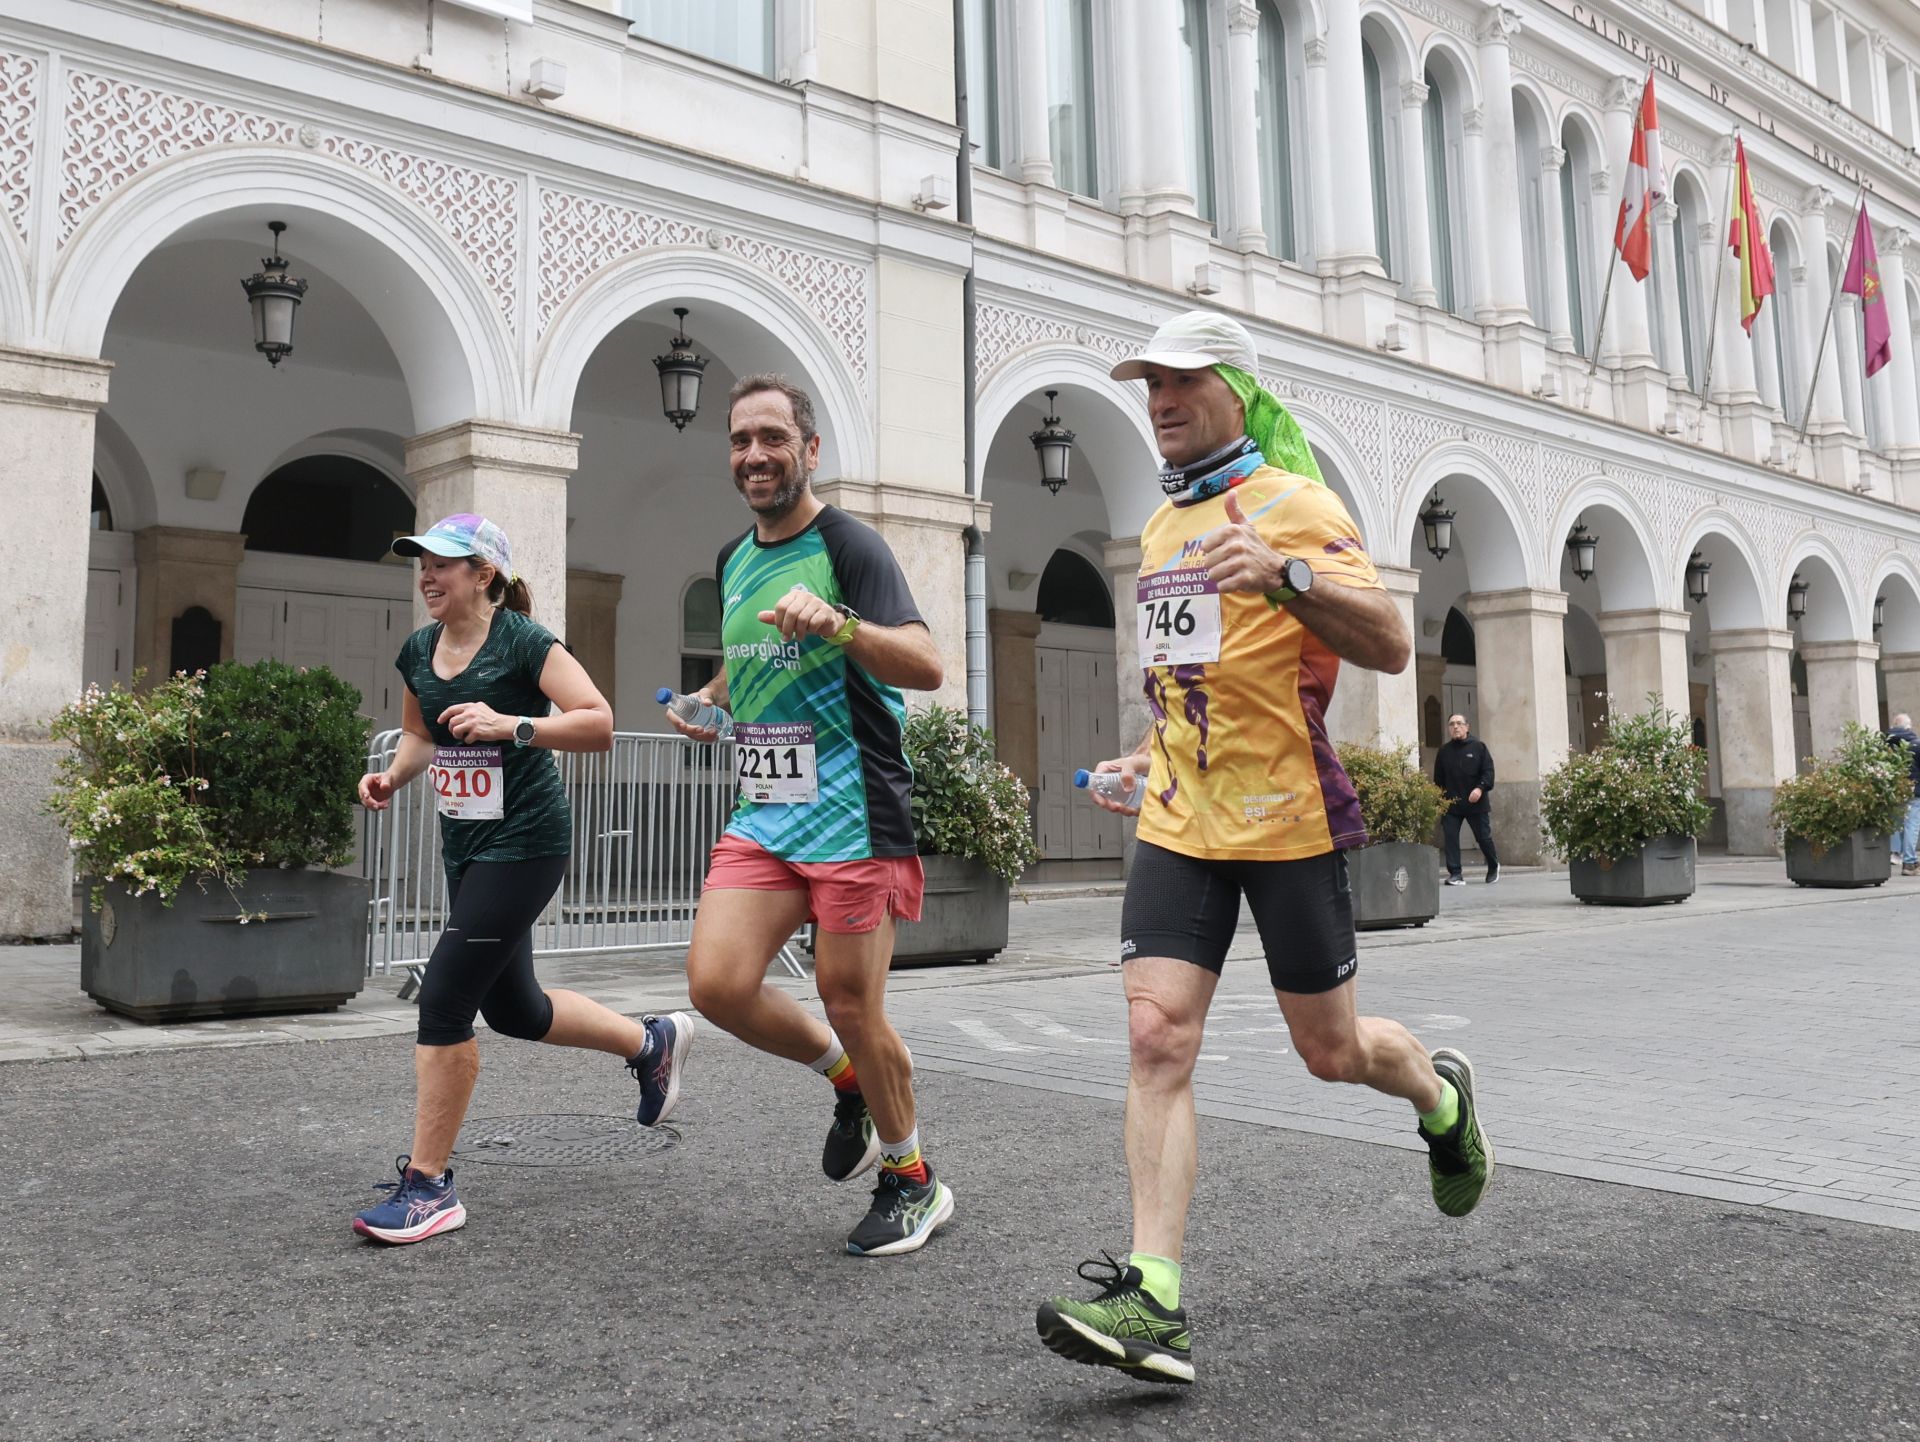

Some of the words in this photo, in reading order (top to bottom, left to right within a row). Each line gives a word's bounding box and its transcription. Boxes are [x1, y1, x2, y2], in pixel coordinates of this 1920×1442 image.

[1710, 83, 1729, 105] DE
[1758, 112, 1775, 136] LA
[1151, 575, 1171, 587] MEDIA
[1172, 569, 1210, 584] MARATÓ
[1147, 589, 1154, 599] DE
[1154, 584, 1205, 597] VALLADOLID
[1145, 598, 1196, 640] 746
[746, 726, 766, 736] MEDIA
[767, 723, 812, 735] MARATÓN
[744, 735, 751, 745] DE
[751, 736, 800, 745] VALLADOLID
[459, 748, 499, 758] MARATÓN
[441, 759, 489, 767] VALLADOLID
[738, 746, 804, 779] 2211
[429, 767, 492, 798] 2210
